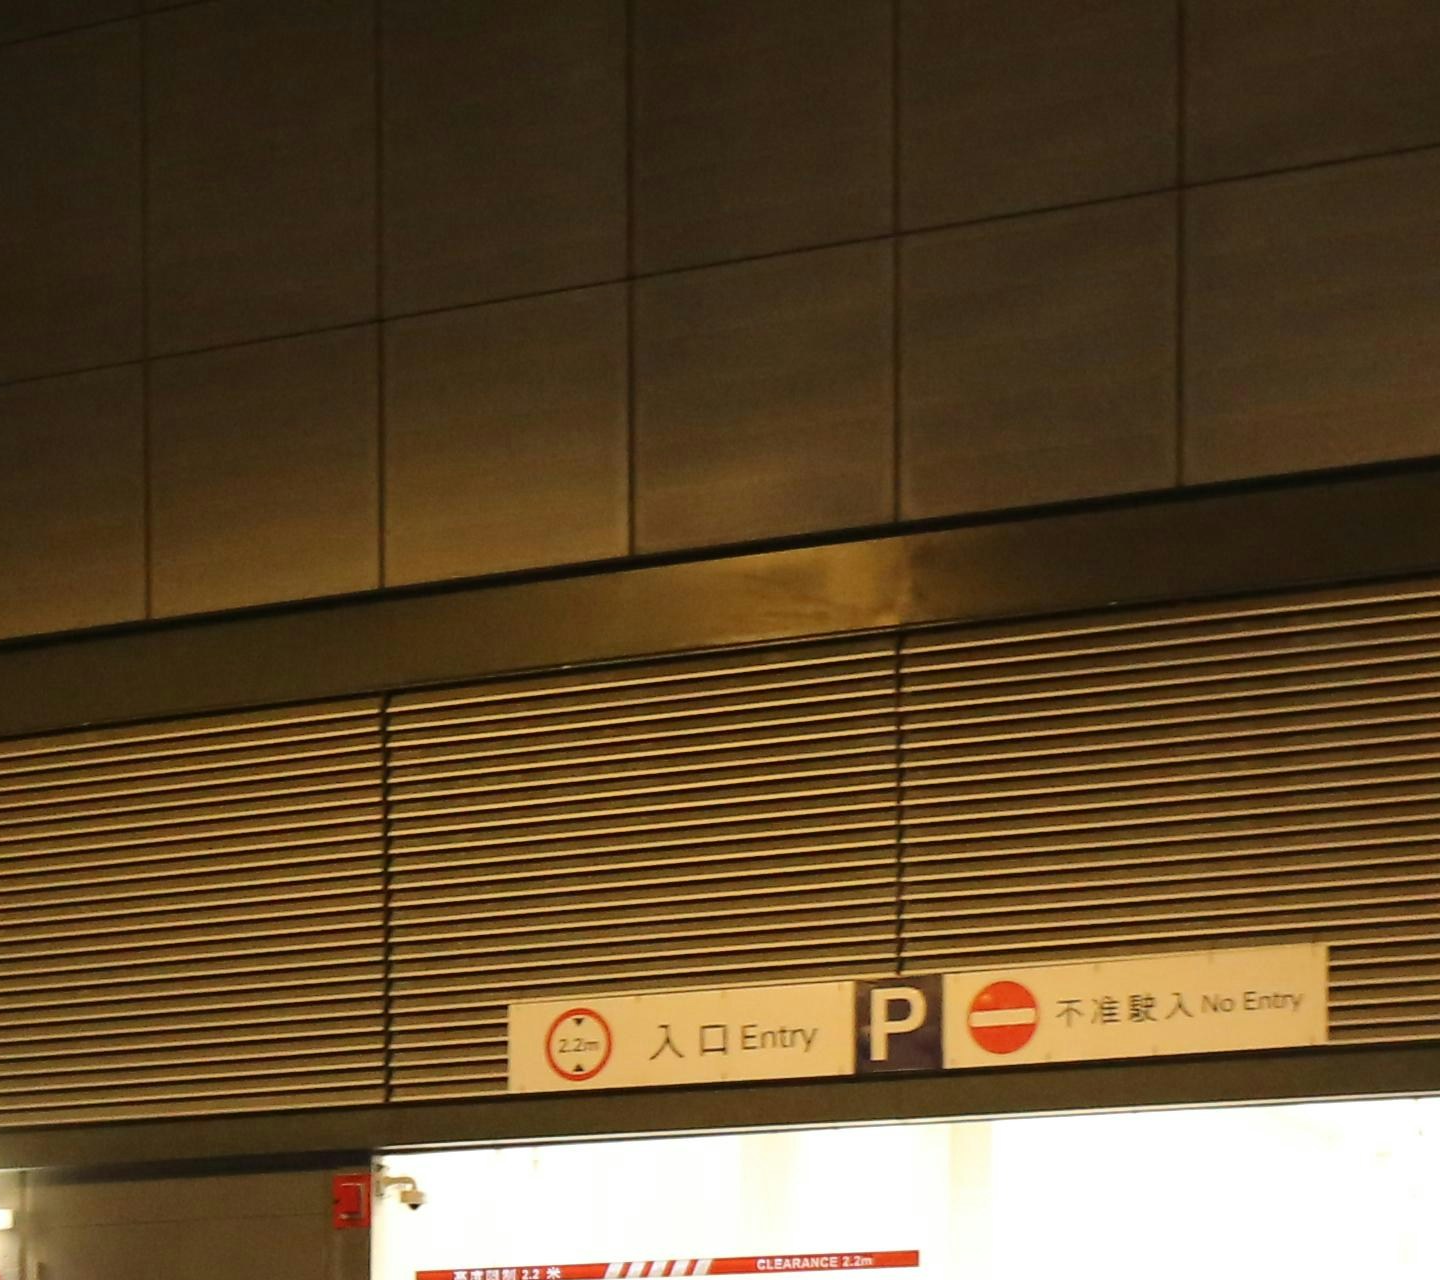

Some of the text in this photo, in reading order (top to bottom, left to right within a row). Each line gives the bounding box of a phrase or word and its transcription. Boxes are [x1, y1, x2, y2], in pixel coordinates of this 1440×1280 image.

[870, 986, 928, 1062] P
[1055, 989, 1304, 1028] 不准駛入 No Entry
[558, 1037, 600, 1054] 2.2m
[649, 1023, 818, 1060] 入口 Entry
[756, 1256, 838, 1271] CLEARANCE
